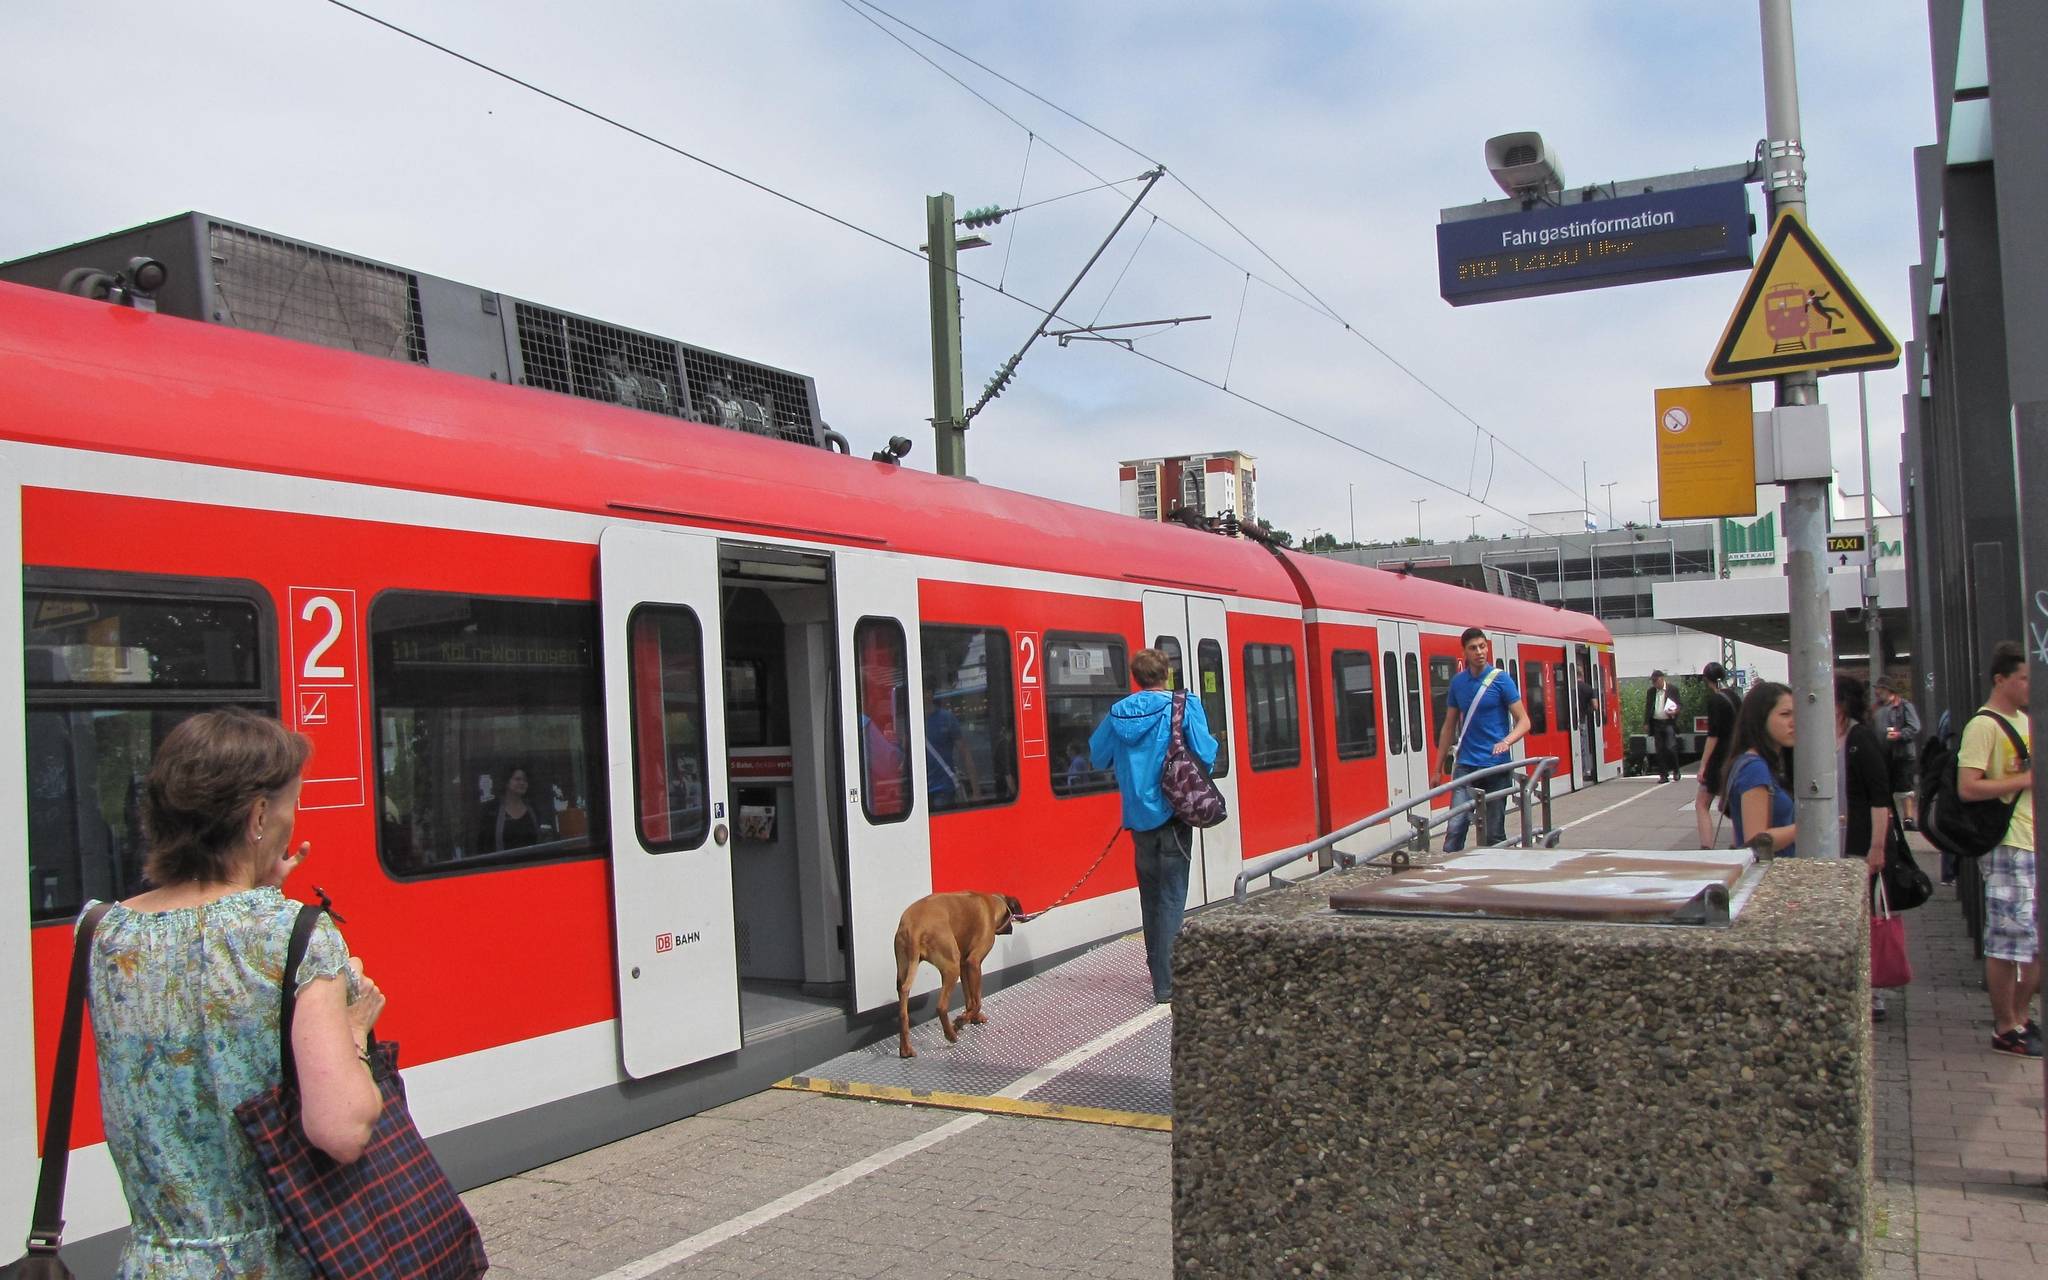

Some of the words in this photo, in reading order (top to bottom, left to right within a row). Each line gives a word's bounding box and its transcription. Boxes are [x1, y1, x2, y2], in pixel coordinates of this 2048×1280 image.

[1501, 209, 1675, 248] Fahrgastinformation
[1728, 551, 1774, 561] ARKTKAUF
[1827, 538, 1858, 550] TAXI
[302, 596, 345, 678] 2
[1020, 636, 1037, 684] 2
[657, 935, 672, 951] DB
[675, 931, 701, 947] BAHN
